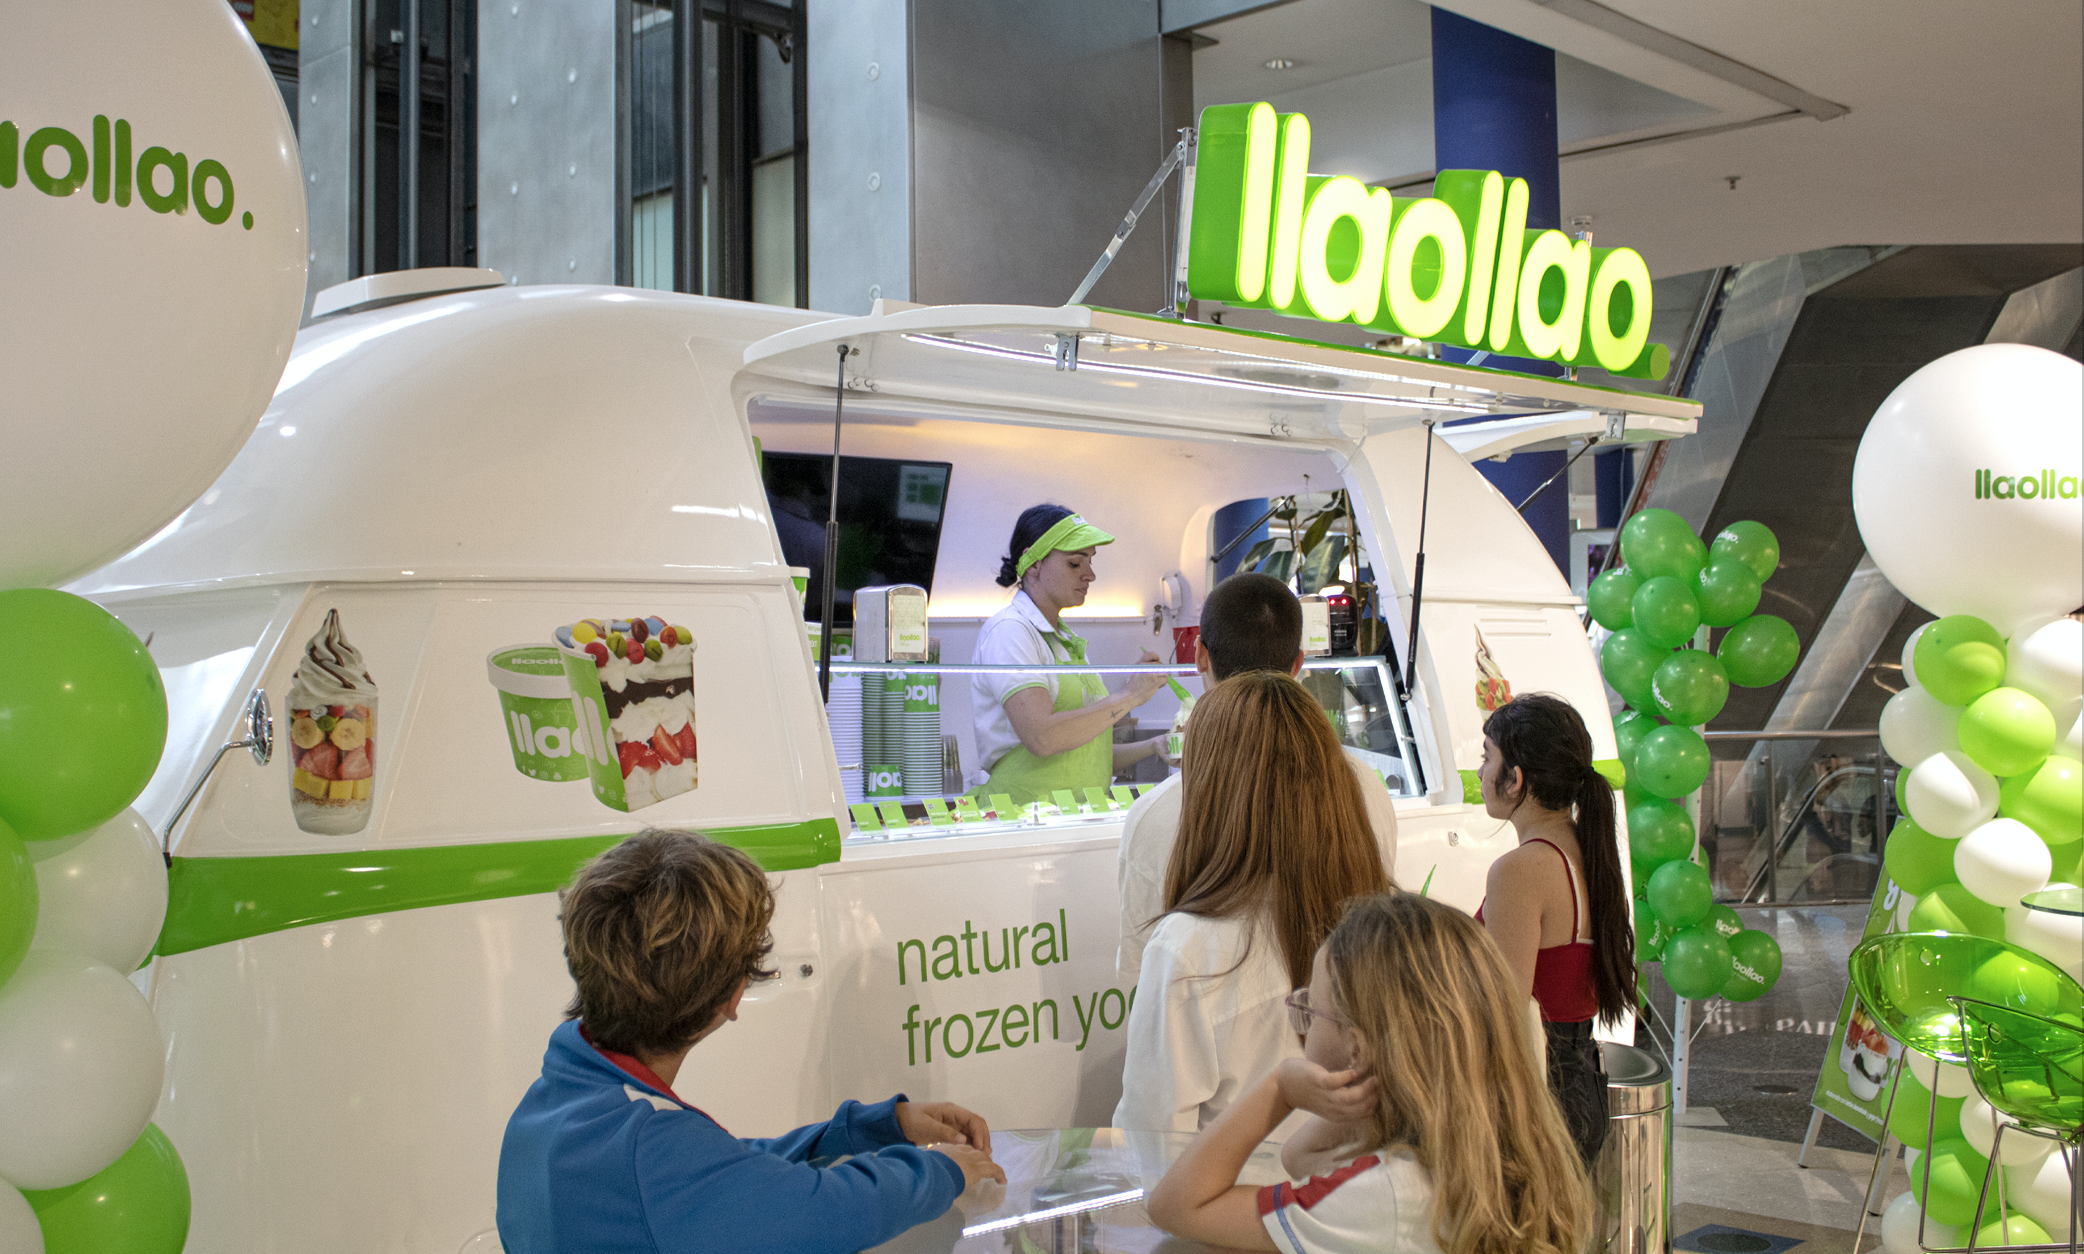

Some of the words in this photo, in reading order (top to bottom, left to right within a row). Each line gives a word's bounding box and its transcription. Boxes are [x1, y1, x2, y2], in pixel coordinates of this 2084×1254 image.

[1975, 468, 2083, 500] llaolla
[897, 908, 1069, 986] natural
[902, 998, 1059, 1067] frozen
[1072, 985, 1138, 1052] yo
